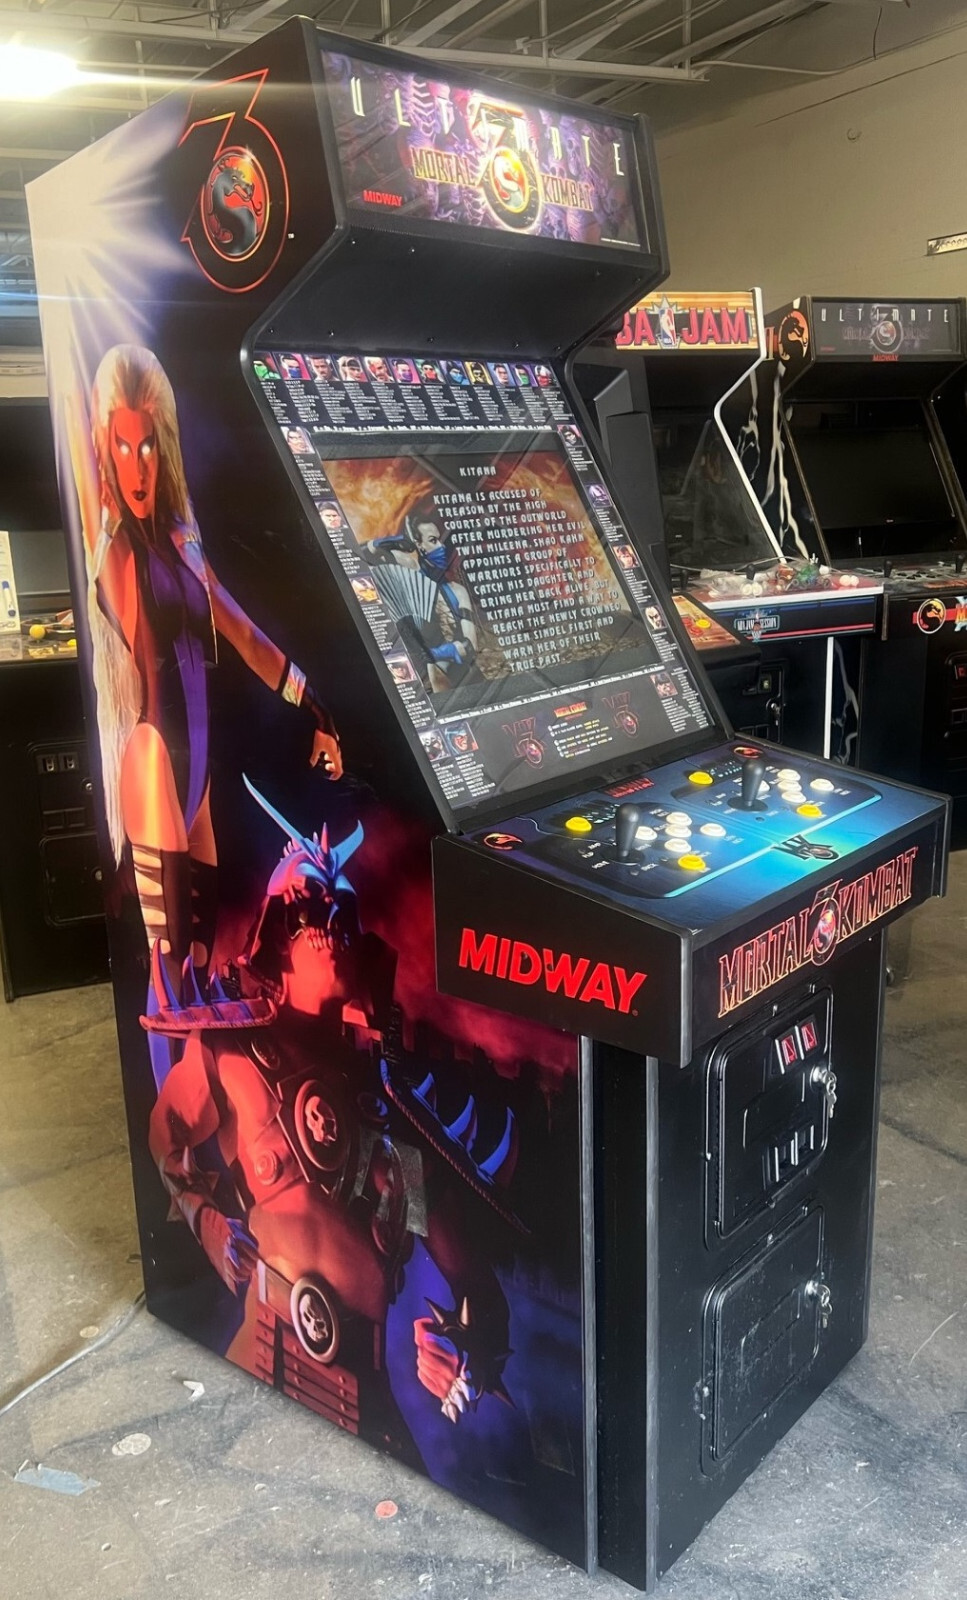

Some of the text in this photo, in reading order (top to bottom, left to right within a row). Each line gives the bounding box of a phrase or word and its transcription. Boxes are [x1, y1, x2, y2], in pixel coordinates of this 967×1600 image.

[409, 145, 482, 189] MORTAL
[538, 173, 594, 212] KOMBAT
[363, 189, 403, 207] MIDWAY
[681, 307, 749, 345] JAM
[820, 308, 949, 322] ULTIMATE
[460, 466, 496, 476] KITANA
[433, 488, 541, 504] KITANA IS ACCUSED OF
[438, 500, 547, 517] TREASON BY THE HIGH
[444, 510, 566, 530] COURTS OF THE OUTWORLD
[451, 521, 585, 544] AFTER MURDERING HER EVIL
[456, 544, 483, 556] TWIN
[533, 536, 556, 547] SHAO
[560, 533, 584, 544] KAHN
[463, 548, 567, 570] APPOINTS A GROUP OF
[467, 556, 595, 582] WARRIORS SPECIFICALLY TO
[473, 570, 594, 595] CATCH HIS DAUGHTER AND
[480, 595, 512, 608] BRING
[515, 591, 536, 603] HER
[538, 587, 562, 599] BACK
[487, 606, 524, 620] KITANA
[527, 601, 549, 613] MUST
[553, 598, 575, 610] FIND
[578, 596, 584, 605] A
[608, 590, 619, 599] TO
[492, 603, 621, 635] REACH THE NEWLY CROWNED
[498, 616, 614, 646] QUEEN SINDEL FIRST AND
[503, 631, 600, 659] WARN HER OF THEIR
[510, 659, 535, 672] TRUE
[718, 908, 814, 1018] MORTAL
[836, 846, 918, 944] KOMBAT
[459, 927, 648, 1014] MIDWAY
